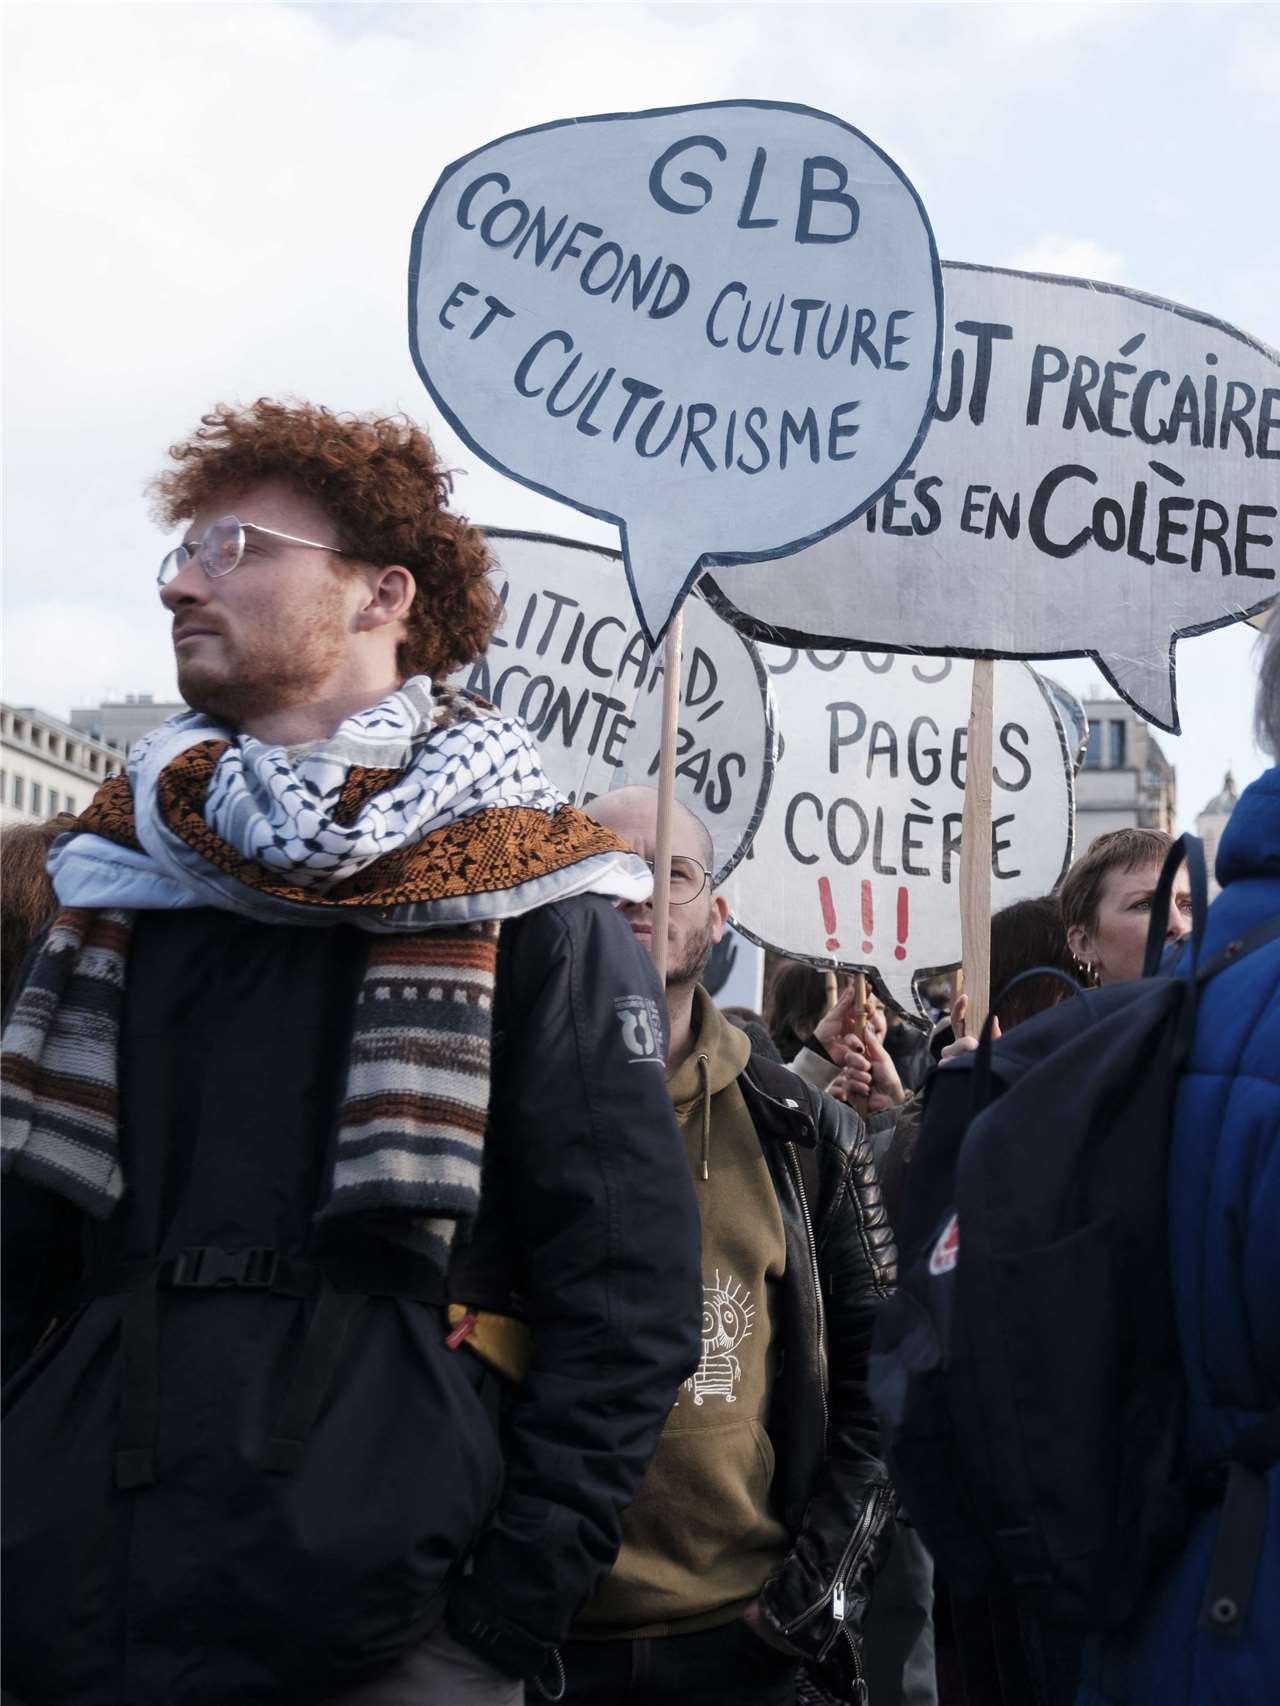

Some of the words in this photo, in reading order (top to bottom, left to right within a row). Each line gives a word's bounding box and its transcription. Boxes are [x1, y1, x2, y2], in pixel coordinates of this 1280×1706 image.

[648, 135, 861, 244] GLB
[456, 172, 691, 320] CONFOND
[705, 280, 915, 371] CULTURE
[438, 281, 517, 341] ET
[513, 329, 863, 475] CULTURISME
[960, 484, 1021, 541] EN
[825, 701, 1032, 792] PAGES
[784, 791, 1022, 884] COLÈRE
